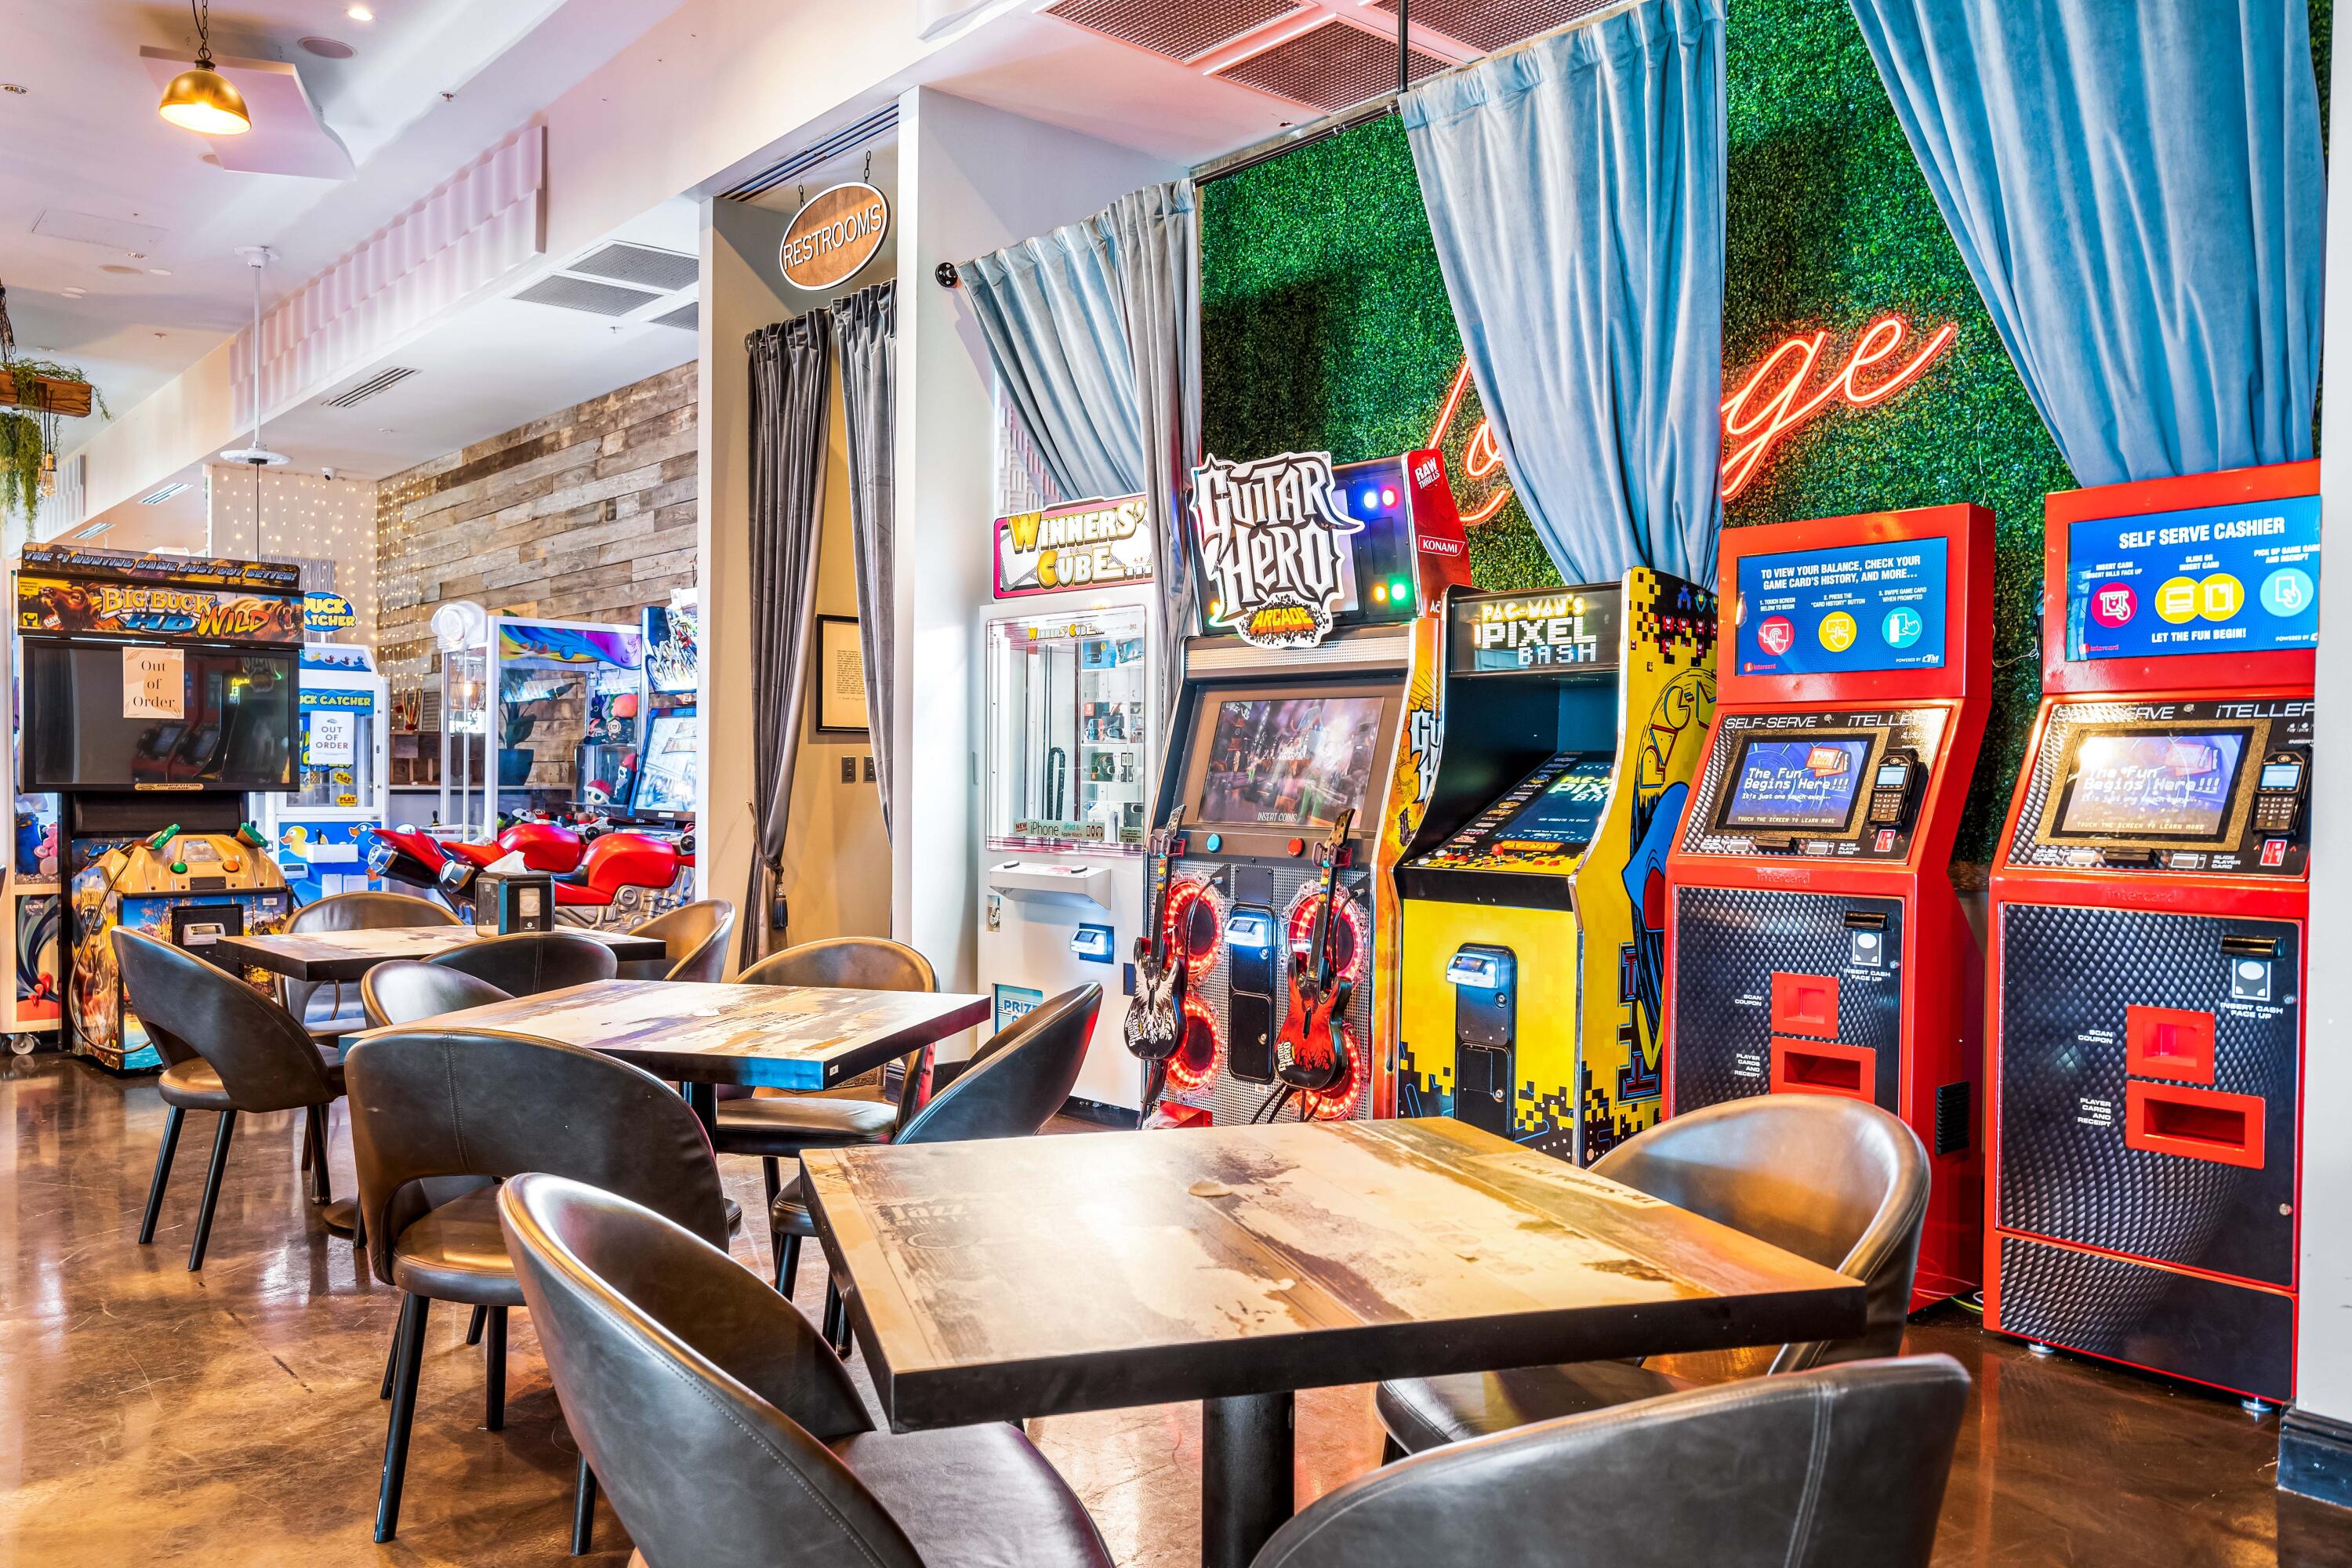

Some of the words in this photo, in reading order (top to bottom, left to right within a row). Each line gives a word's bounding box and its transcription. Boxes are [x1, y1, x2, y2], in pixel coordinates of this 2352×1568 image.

[783, 204, 883, 270] RESTROOMS
[1414, 457, 1437, 482] RAW
[1418, 469, 1440, 489] THRILLS
[1198, 459, 1345, 543] GUITAR
[2118, 530, 2155, 549] SELF
[2159, 524, 2210, 545] SERVE
[2214, 517, 2285, 539] CASHIER
[1423, 539, 1457, 554] KONAMI
[24, 551, 53, 562] THE
[71, 554, 135, 568] HUNTING
[136, 560, 179, 572] GAME
[180, 564, 216, 575] JUST
[217, 566, 244, 577] GOT
[245, 569, 298, 581] BETTER!
[1217, 517, 1334, 618] HERO
[1761, 569, 1772, 579] TO
[1773, 568, 1795, 579] VIEW
[1797, 565, 1819, 576] YOUR
[1821, 561, 1863, 575] BALANCE,
[1864, 558, 1893, 570] CHECK
[1896, 555, 1921, 567] YOUR
[1763, 579, 1787, 590] GAME
[1789, 577, 1819, 589] CARD'S
[1821, 573, 1859, 586] HISTORY,
[1860, 571, 1879, 583] AND
[1881, 568, 1918, 580] MORE...
[100, 588, 147, 616] BIG
[151, 590, 216, 616] BUCK
[1481, 593, 1587, 622] PAC-MAN'S
[125, 613, 196, 632] HD
[197, 605, 270, 636] WILD
[304, 614, 356, 627] TCHER
[1250, 606, 1316, 633] ARCADE
[1482, 616, 1597, 649] PIXEL
[2151, 633, 2168, 643] LET
[2171, 631, 2189, 642] THE
[2191, 630, 2210, 641] FUN
[2213, 628, 2247, 640] BEGIN!
[1518, 643, 1597, 665] BASH
[141, 660, 166, 672] Out
[147, 678, 162, 689] of
[132, 696, 176, 707] Order
[320, 695, 372, 706] CATCHER
[1725, 717, 1817, 729] SELF-SERVE
[1848, 714, 1927, 728] iTELLE
[1639, 677, 1721, 789] PAC-M
[1559, 775, 1614, 784] PAC-M
[1749, 768, 1770, 779] The
[1777, 768, 1802, 779] Fun
[1548, 783, 1612, 794] PIX
[1744, 778, 1791, 791] Begins
[1798, 778, 1849, 790] Here!!!
[2083, 777, 2145, 793] Begins
[1571, 793, 1608, 802] BA
[1258, 811, 1277, 822] INSERT
[1278, 812, 1298, 822] COINS
[1030, 822, 1058, 836] iPhone
[2107, 889, 2177, 902] intercard
[2220, 1003, 2253, 1011] INSERT
[2256, 1006, 2283, 1014] CASH
[2078, 1035, 2113, 1044] COUPON
[2080, 1098, 2111, 1108] PLAYER
[2082, 1105, 2111, 1114] CARDS
[2078, 1118, 2111, 1127] RECEIPT
[891, 1203, 968, 1220] Jazz
